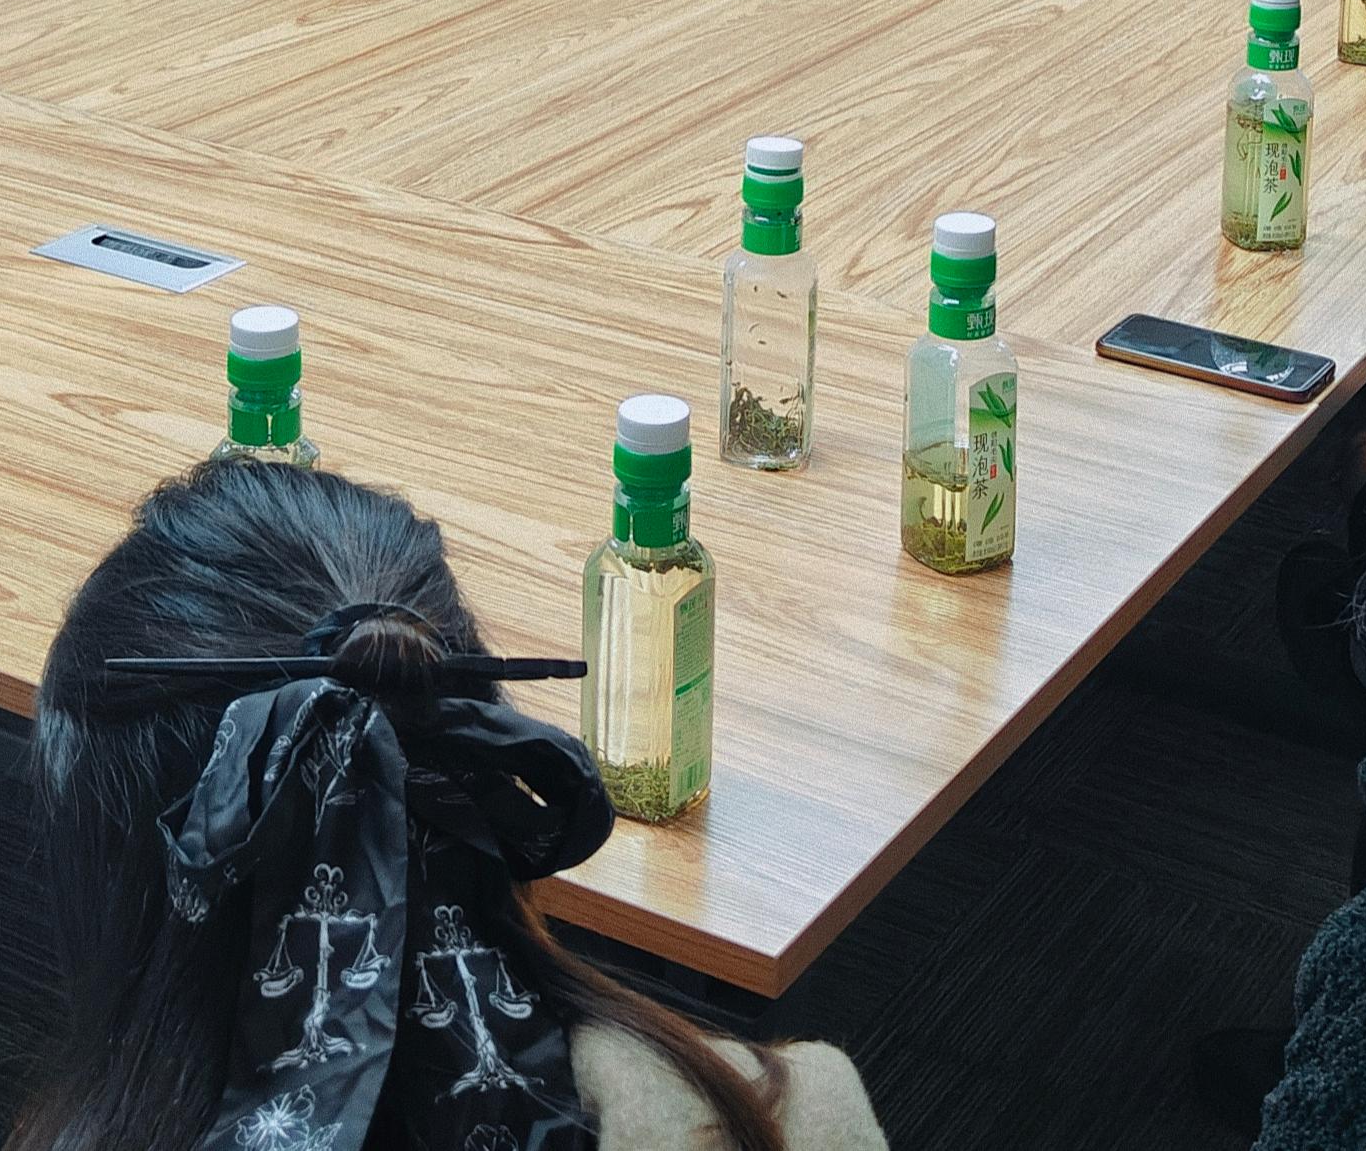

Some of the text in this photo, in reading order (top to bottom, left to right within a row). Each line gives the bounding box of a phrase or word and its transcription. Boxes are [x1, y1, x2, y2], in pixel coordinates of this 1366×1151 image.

[1264, 142, 1280, 194] 现泡茶
[972, 432, 990, 500] 现泡茶
